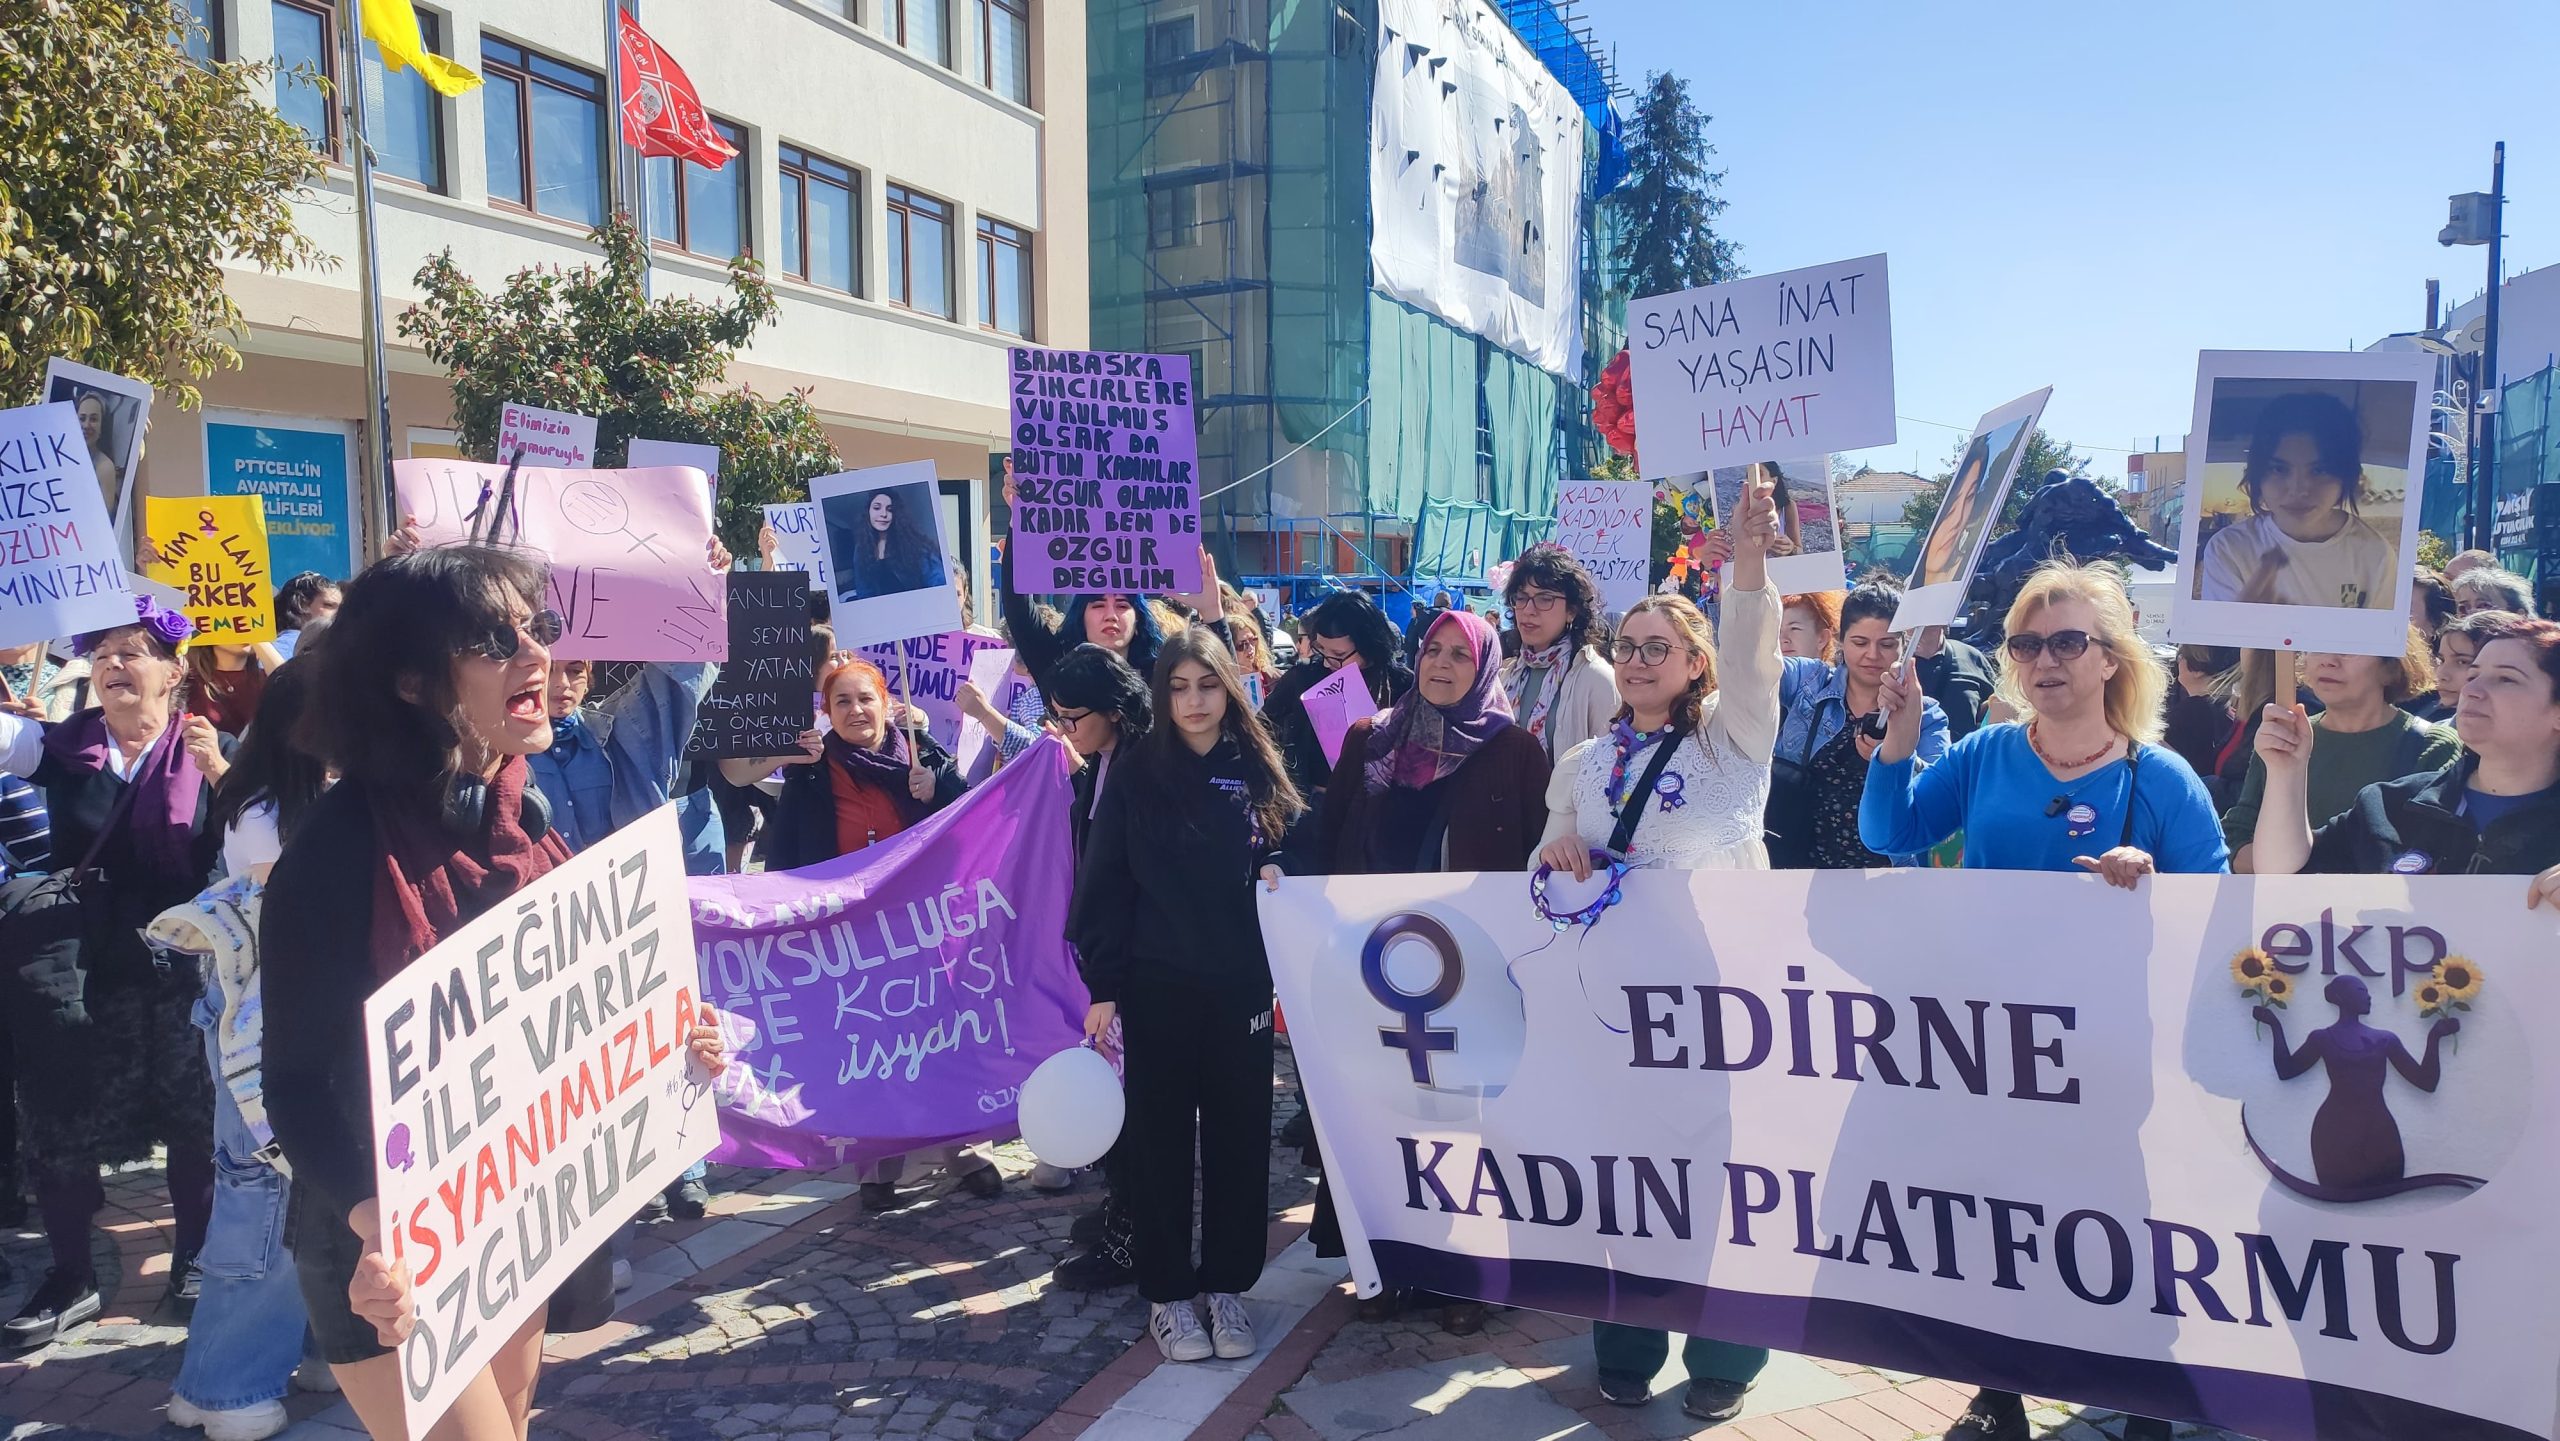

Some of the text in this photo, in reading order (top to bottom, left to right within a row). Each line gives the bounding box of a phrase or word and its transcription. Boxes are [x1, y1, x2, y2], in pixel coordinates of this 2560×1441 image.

[1643, 273, 1865, 350] SANA İNAT
[1677, 333, 1835, 394] YAŞASIN
[504, 408, 571, 436] Elimizin
[1016, 423, 1160, 454] OLSAK DA
[1700, 393, 1821, 451] HAYAT
[236, 480, 321, 497] AVANTAJLI
[1097, 453, 1192, 484] KADINLAR
[0, 478, 71, 522] İZSE
[263, 498, 323, 517] LİFLERİ
[1559, 486, 1628, 505] KADIN
[1020, 506, 1196, 534] KADAR BEN DE
[1558, 507, 1644, 529] KADINDIR
[158, 531, 263, 577] KİM LAN
[190, 562, 220, 583] BU
[173, 581, 257, 608] RKEK
[190, 613, 265, 634] EMEN
[2260, 907, 2448, 998] ekp
[384, 849, 657, 1106] EMEĞİMİZ
[422, 928, 668, 1171] İLE VARIZ
[1620, 965, 2081, 1105] EDİRNE
[393, 985, 698, 1287] İSYANIMIZLA
[405, 1094, 657, 1402] ÖZGÜRÜZ
[1396, 1136, 2462, 1355] KADIN PLATFORMU
